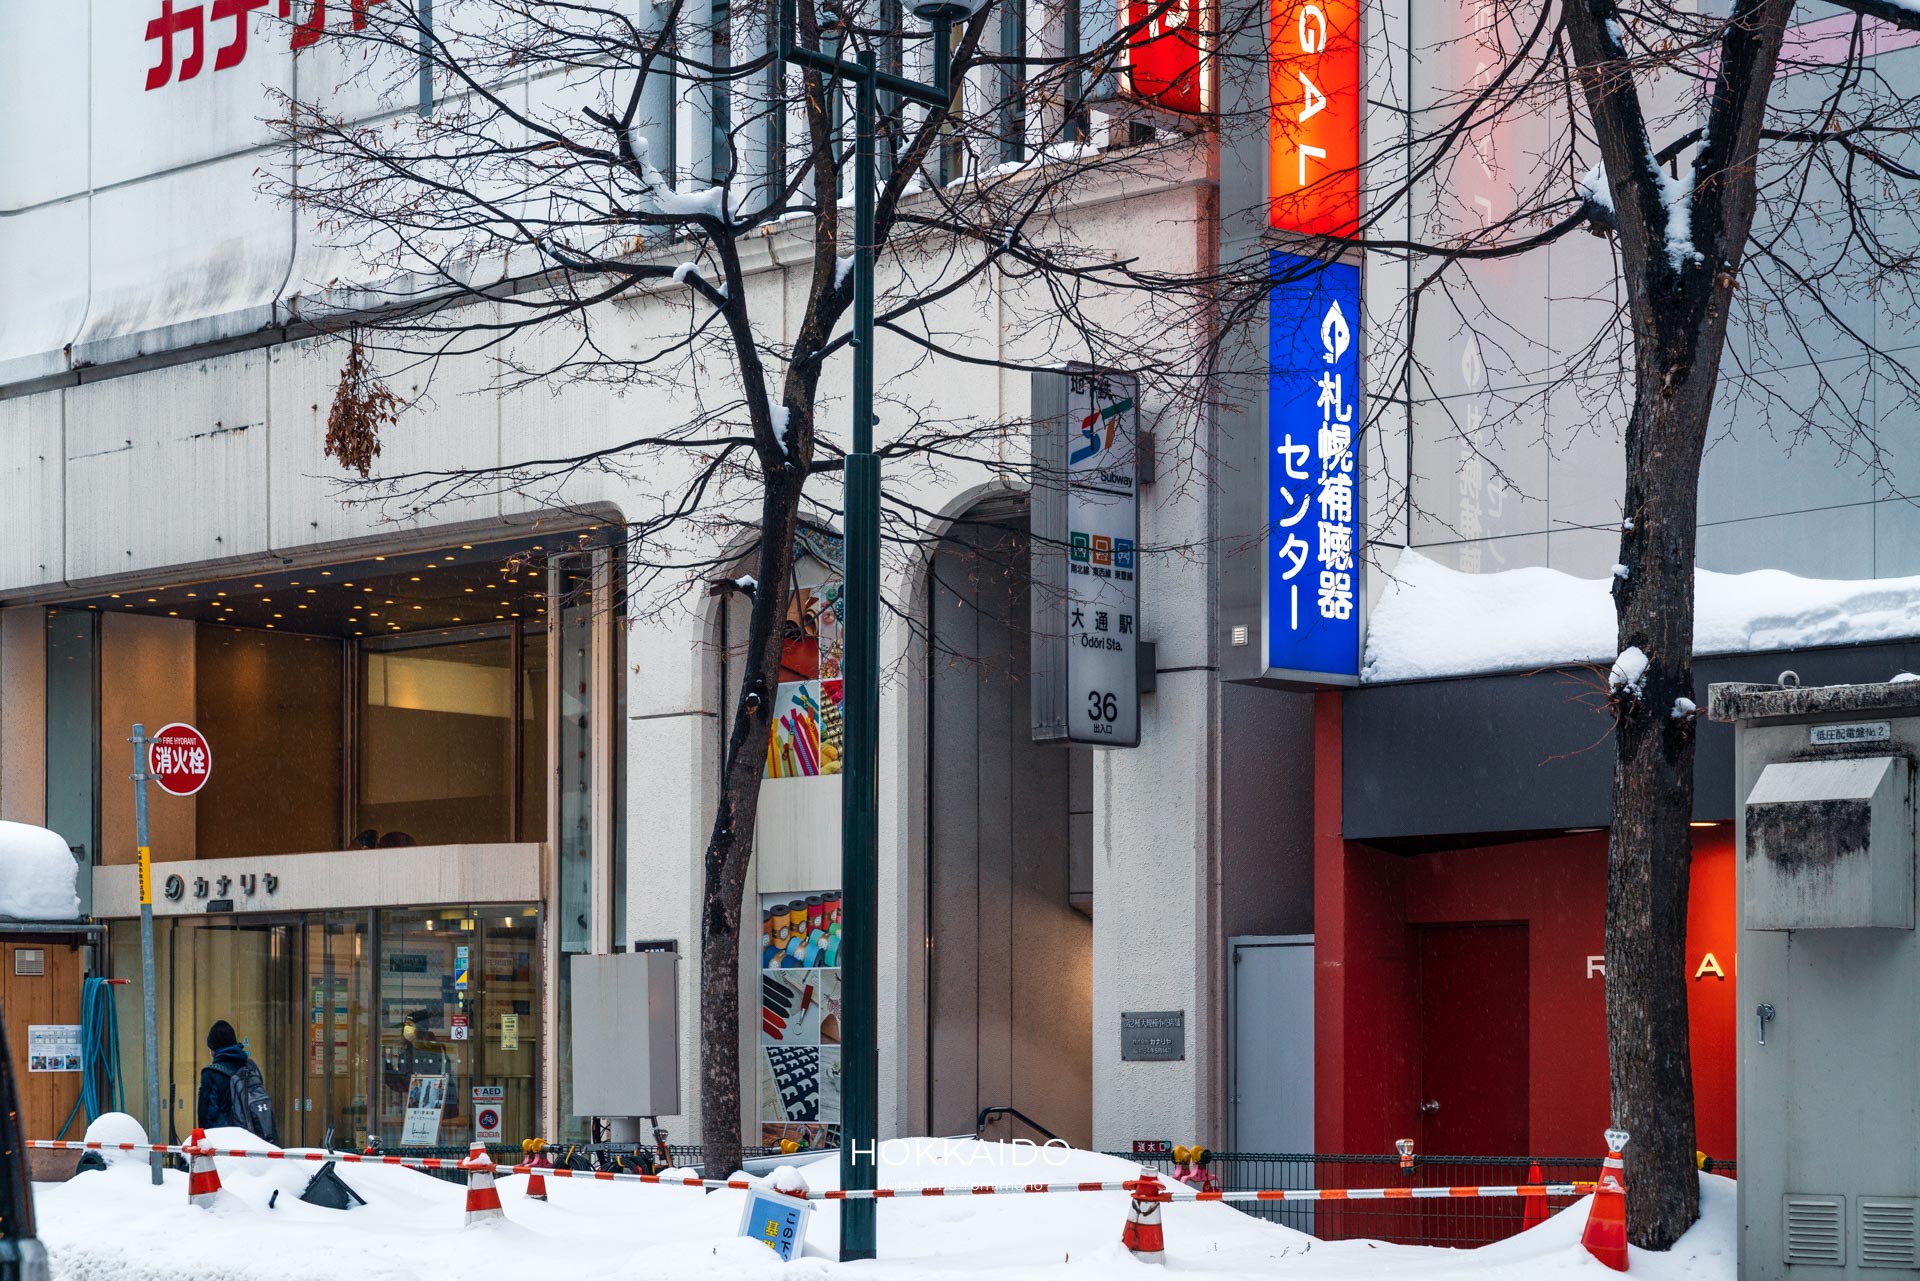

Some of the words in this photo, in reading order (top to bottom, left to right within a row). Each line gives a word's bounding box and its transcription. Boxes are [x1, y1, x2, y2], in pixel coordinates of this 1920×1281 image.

[1100, 470, 1133, 488] Subway
[1317, 371, 1354, 620] 札幌補聴器
[1277, 434, 1310, 630] センター
[1106, 638, 1123, 651] Sta.
[1088, 690, 1117, 723] 36
[1093, 723, 1113, 735] 出入口
[163, 736, 174, 745] FIRE
[174, 736, 197, 746] HYDRANT
[156, 746, 206, 775] 消火栓
[193, 872, 278, 898] カナリヤ
[482, 1087, 501, 1095] AED
